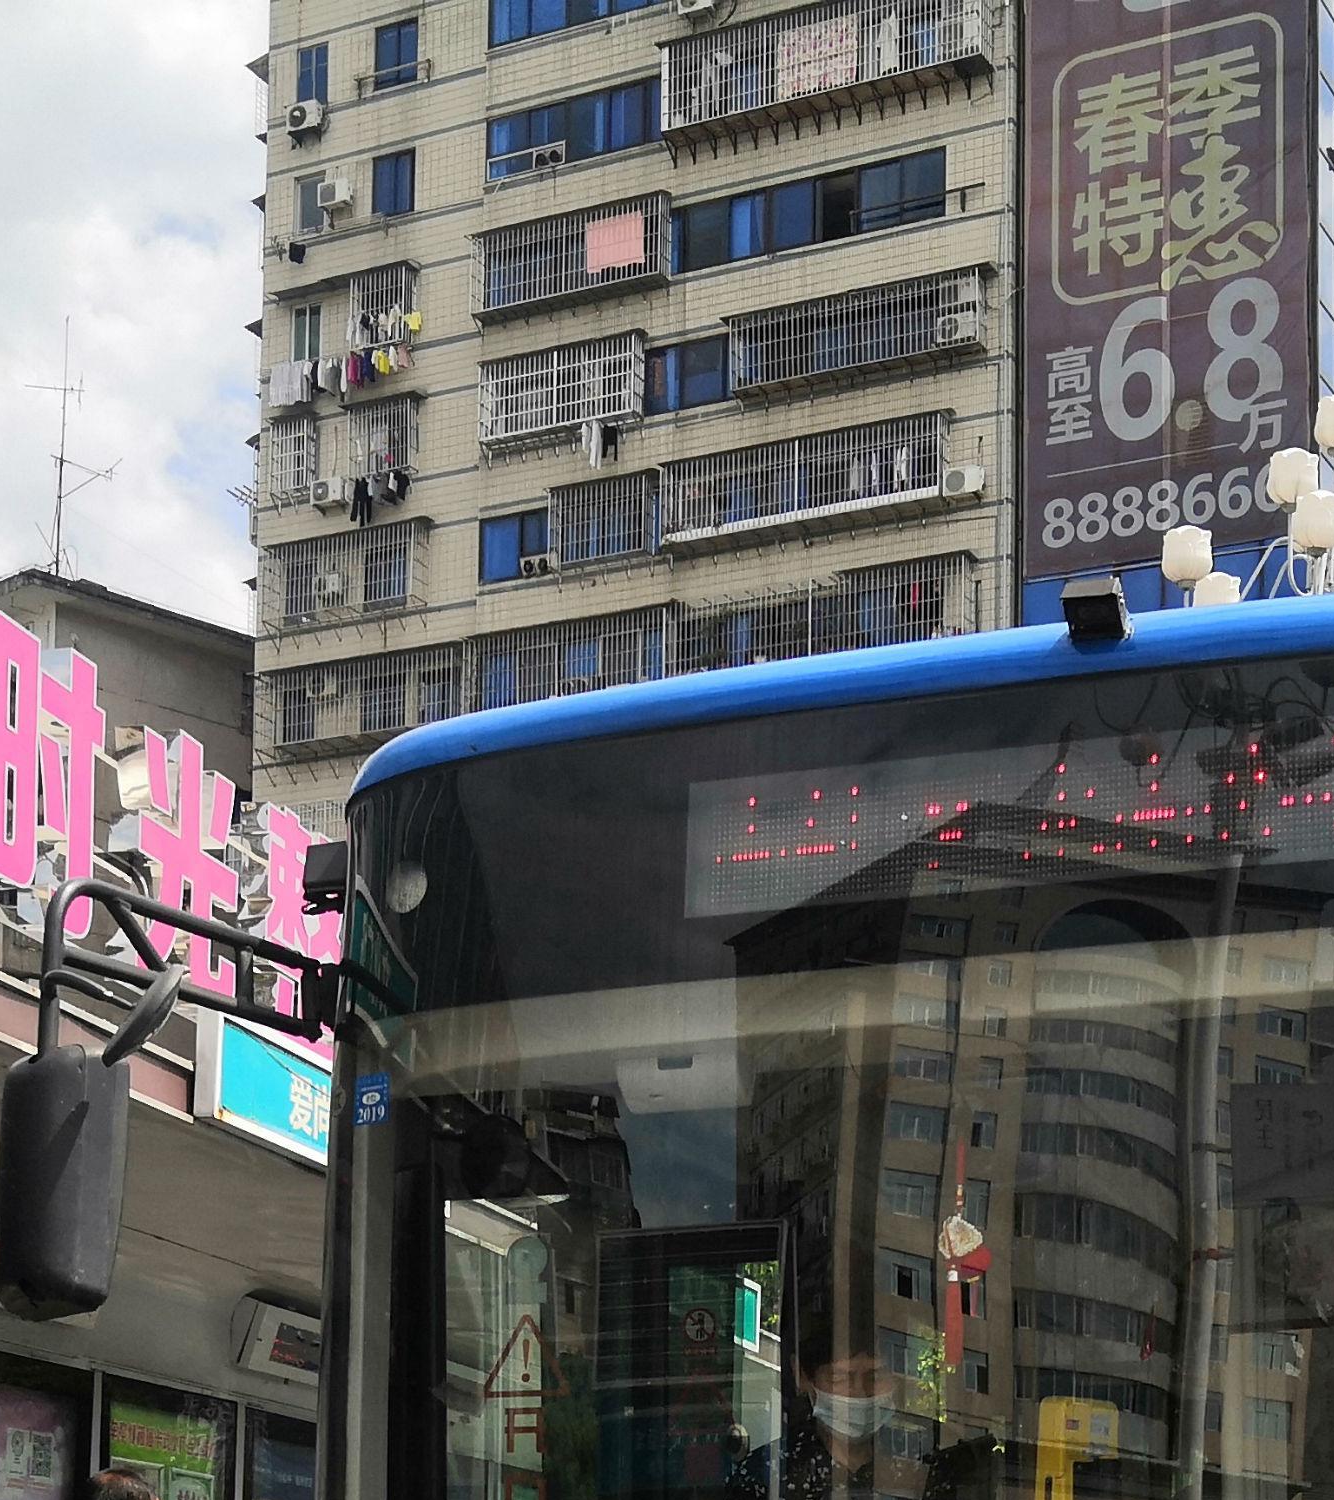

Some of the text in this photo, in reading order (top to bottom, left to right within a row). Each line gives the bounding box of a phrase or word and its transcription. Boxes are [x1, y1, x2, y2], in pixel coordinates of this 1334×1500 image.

[1073, 44, 1262, 175] 春季
[1046, 345, 1094, 447] 高至
[1238, 397, 1288, 454] 万
[357, 1105, 385, 1124] 2019
